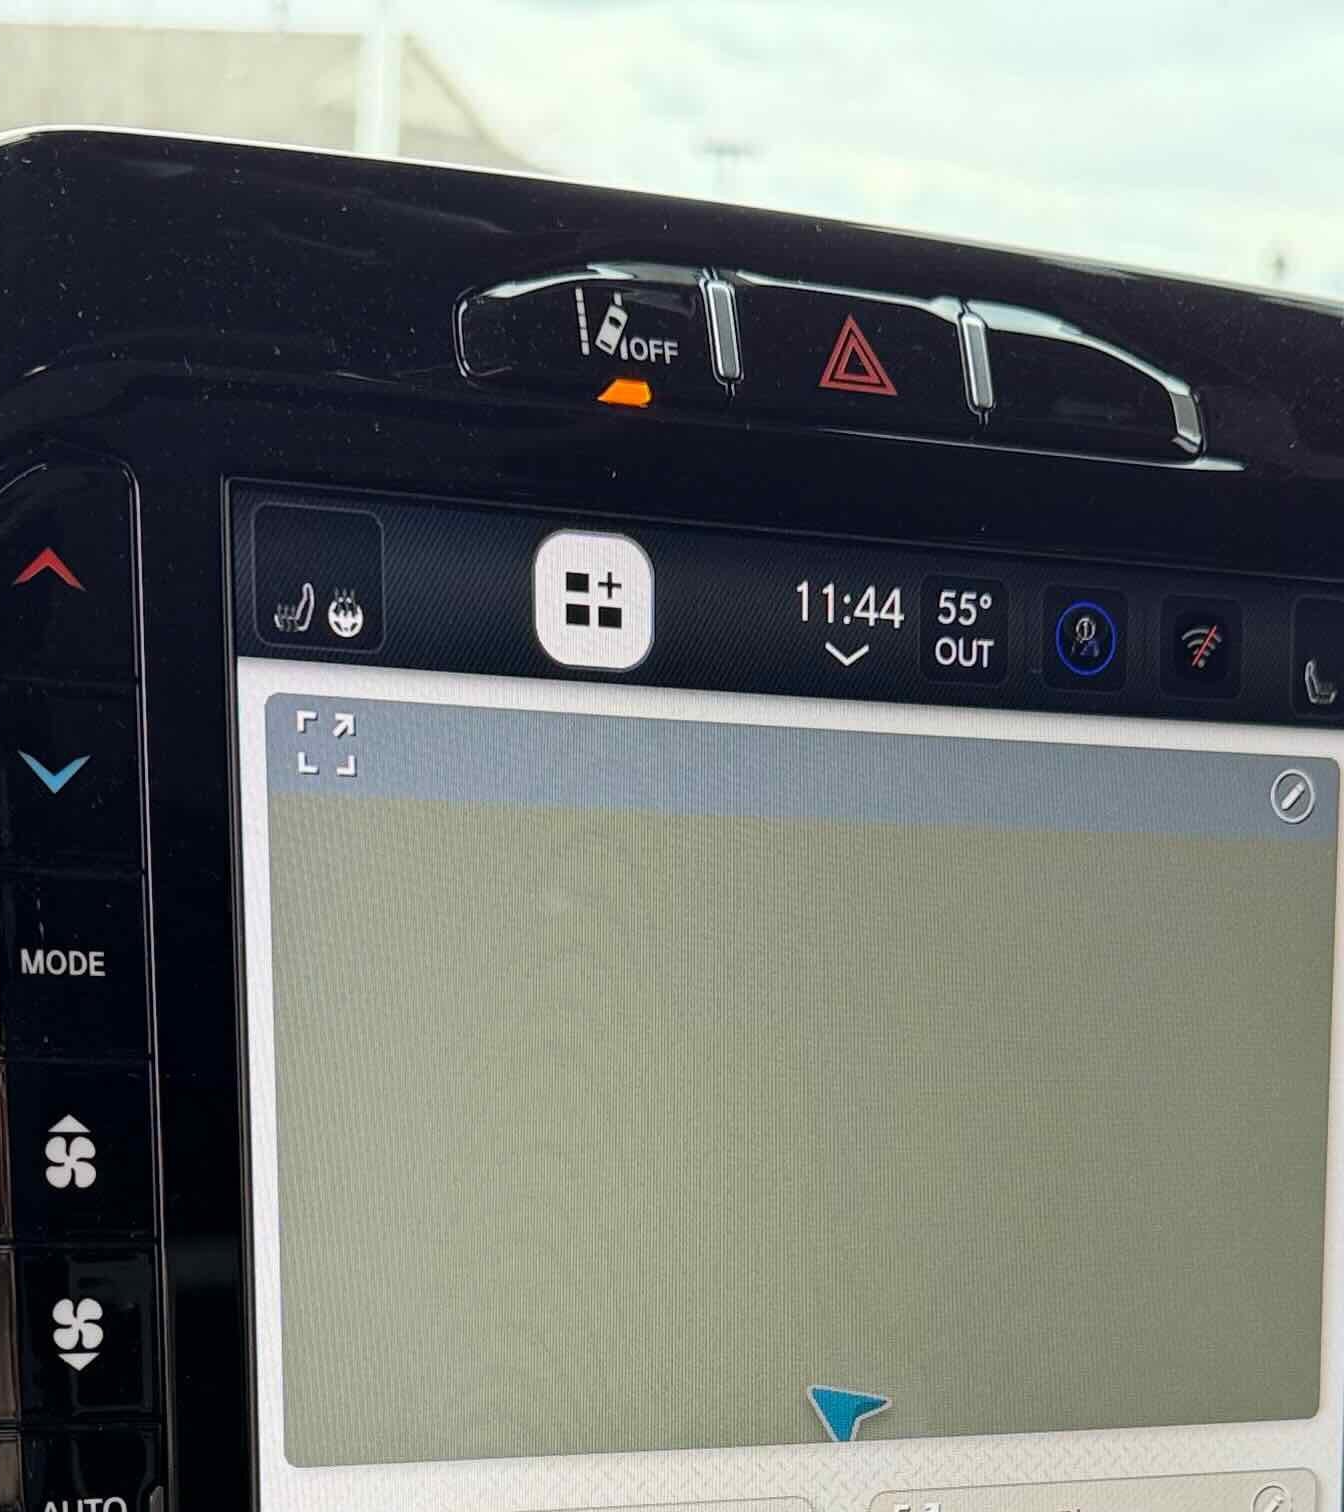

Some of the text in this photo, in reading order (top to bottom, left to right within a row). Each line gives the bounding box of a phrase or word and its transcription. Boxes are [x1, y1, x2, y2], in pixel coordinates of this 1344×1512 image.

[630, 339, 678, 365] OFF
[797, 581, 904, 629] 11:44
[937, 591, 993, 627] 55°
[935, 638, 993, 669] OUT
[20, 948, 105, 977] MODE
